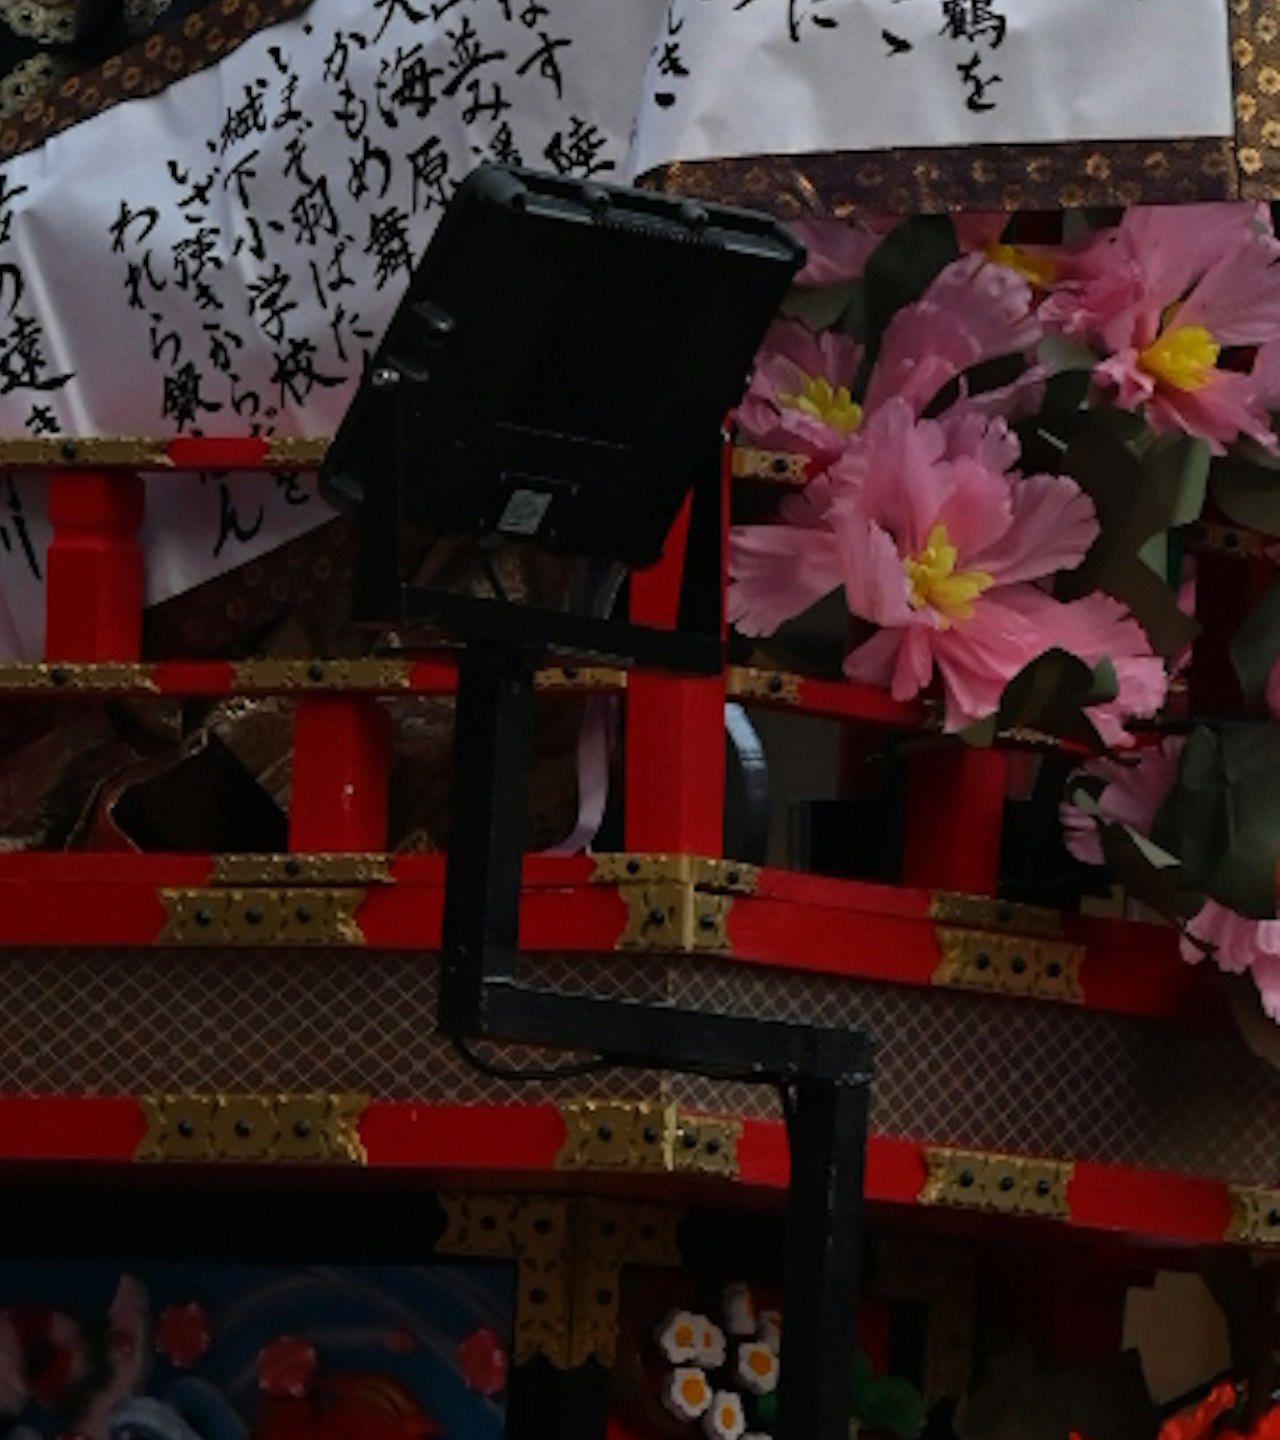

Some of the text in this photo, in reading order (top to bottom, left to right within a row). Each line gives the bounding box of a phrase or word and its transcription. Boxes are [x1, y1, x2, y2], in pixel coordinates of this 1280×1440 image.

[219, 78, 347, 409] 城下小学校
[266, 24, 374, 388] いまぞ羽ばた
